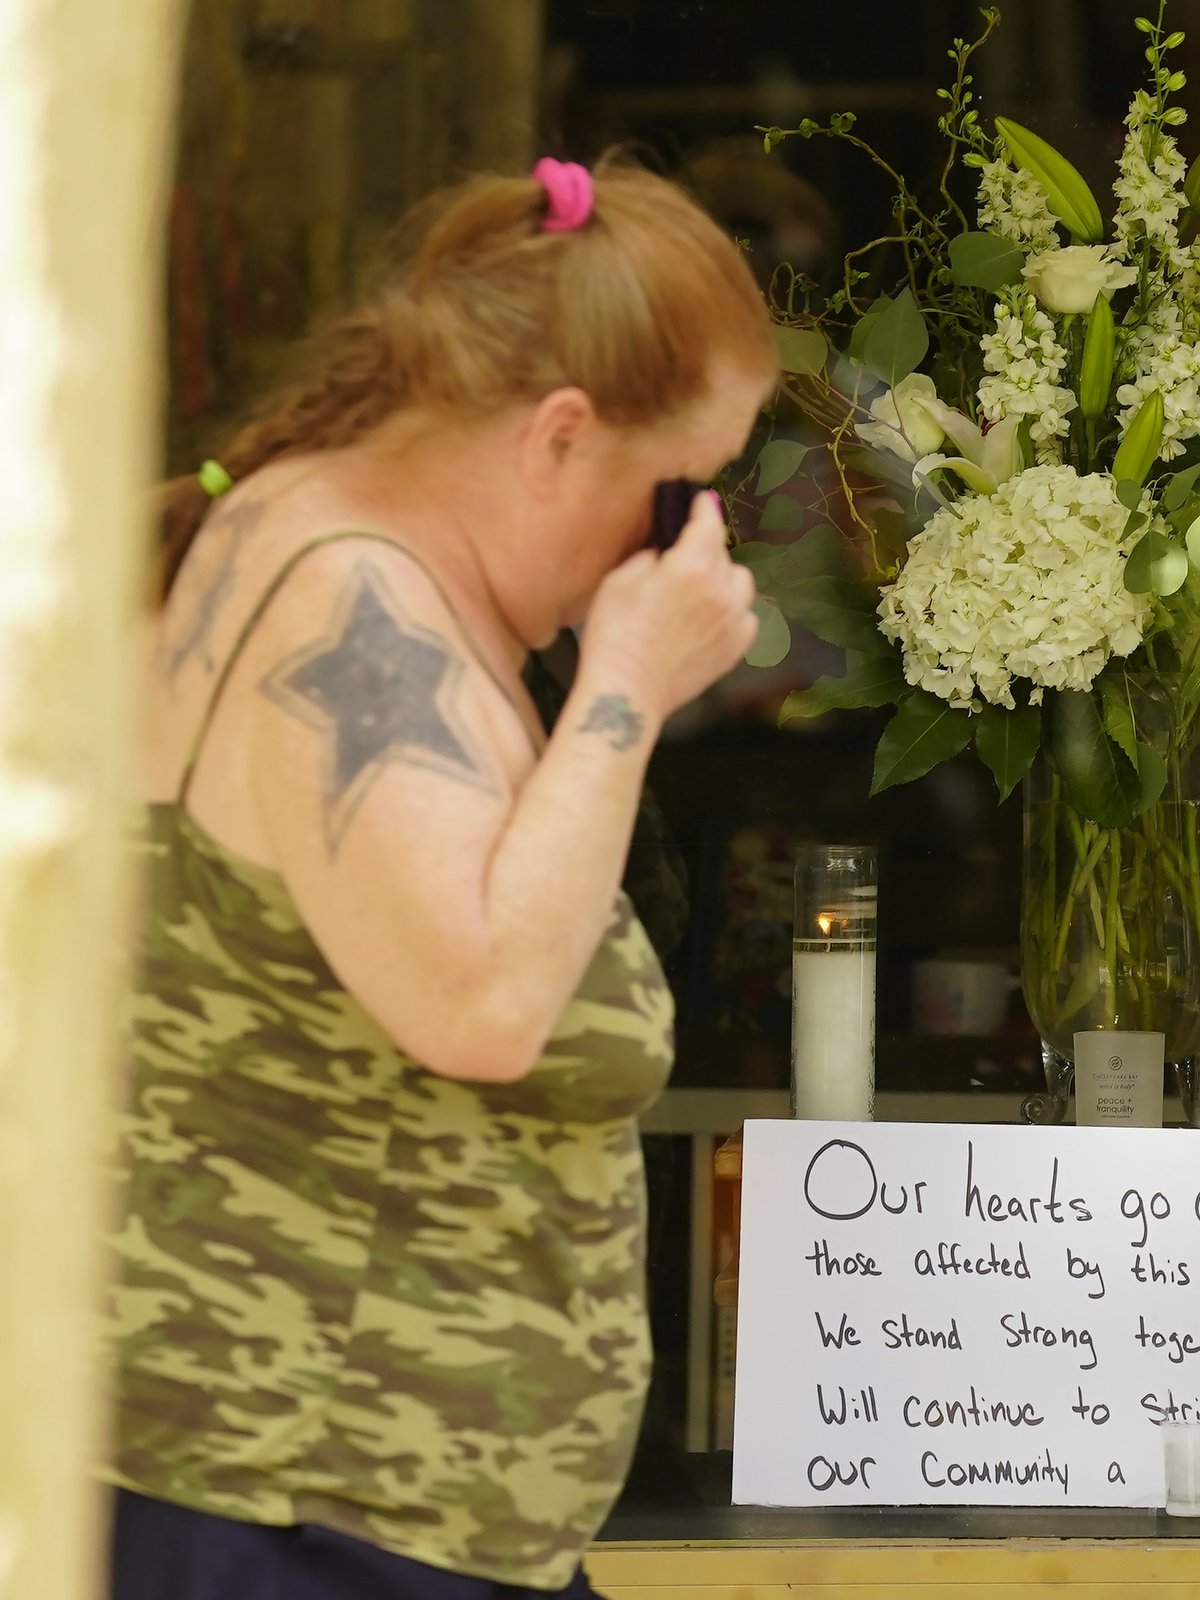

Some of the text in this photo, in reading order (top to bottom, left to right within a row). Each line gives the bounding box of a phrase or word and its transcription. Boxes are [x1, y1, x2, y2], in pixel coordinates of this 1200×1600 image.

[1097, 1097, 1125, 1105] peace
[804, 1138, 928, 1221] Our
[965, 1140, 1093, 1223] hearts
[1120, 1188, 1171, 1248] go
[804, 1238, 882, 1276] those
[914, 1241, 1031, 1279] affected
[1066, 1247, 1106, 1300] by
[1130, 1252, 1191, 1286] this
[814, 1311, 862, 1350] We
[816, 1383, 879, 1426] Will
[1071, 1385, 1110, 1426] to
[921, 1448, 1069, 1495] Community
[1107, 1461, 1126, 1485] a
